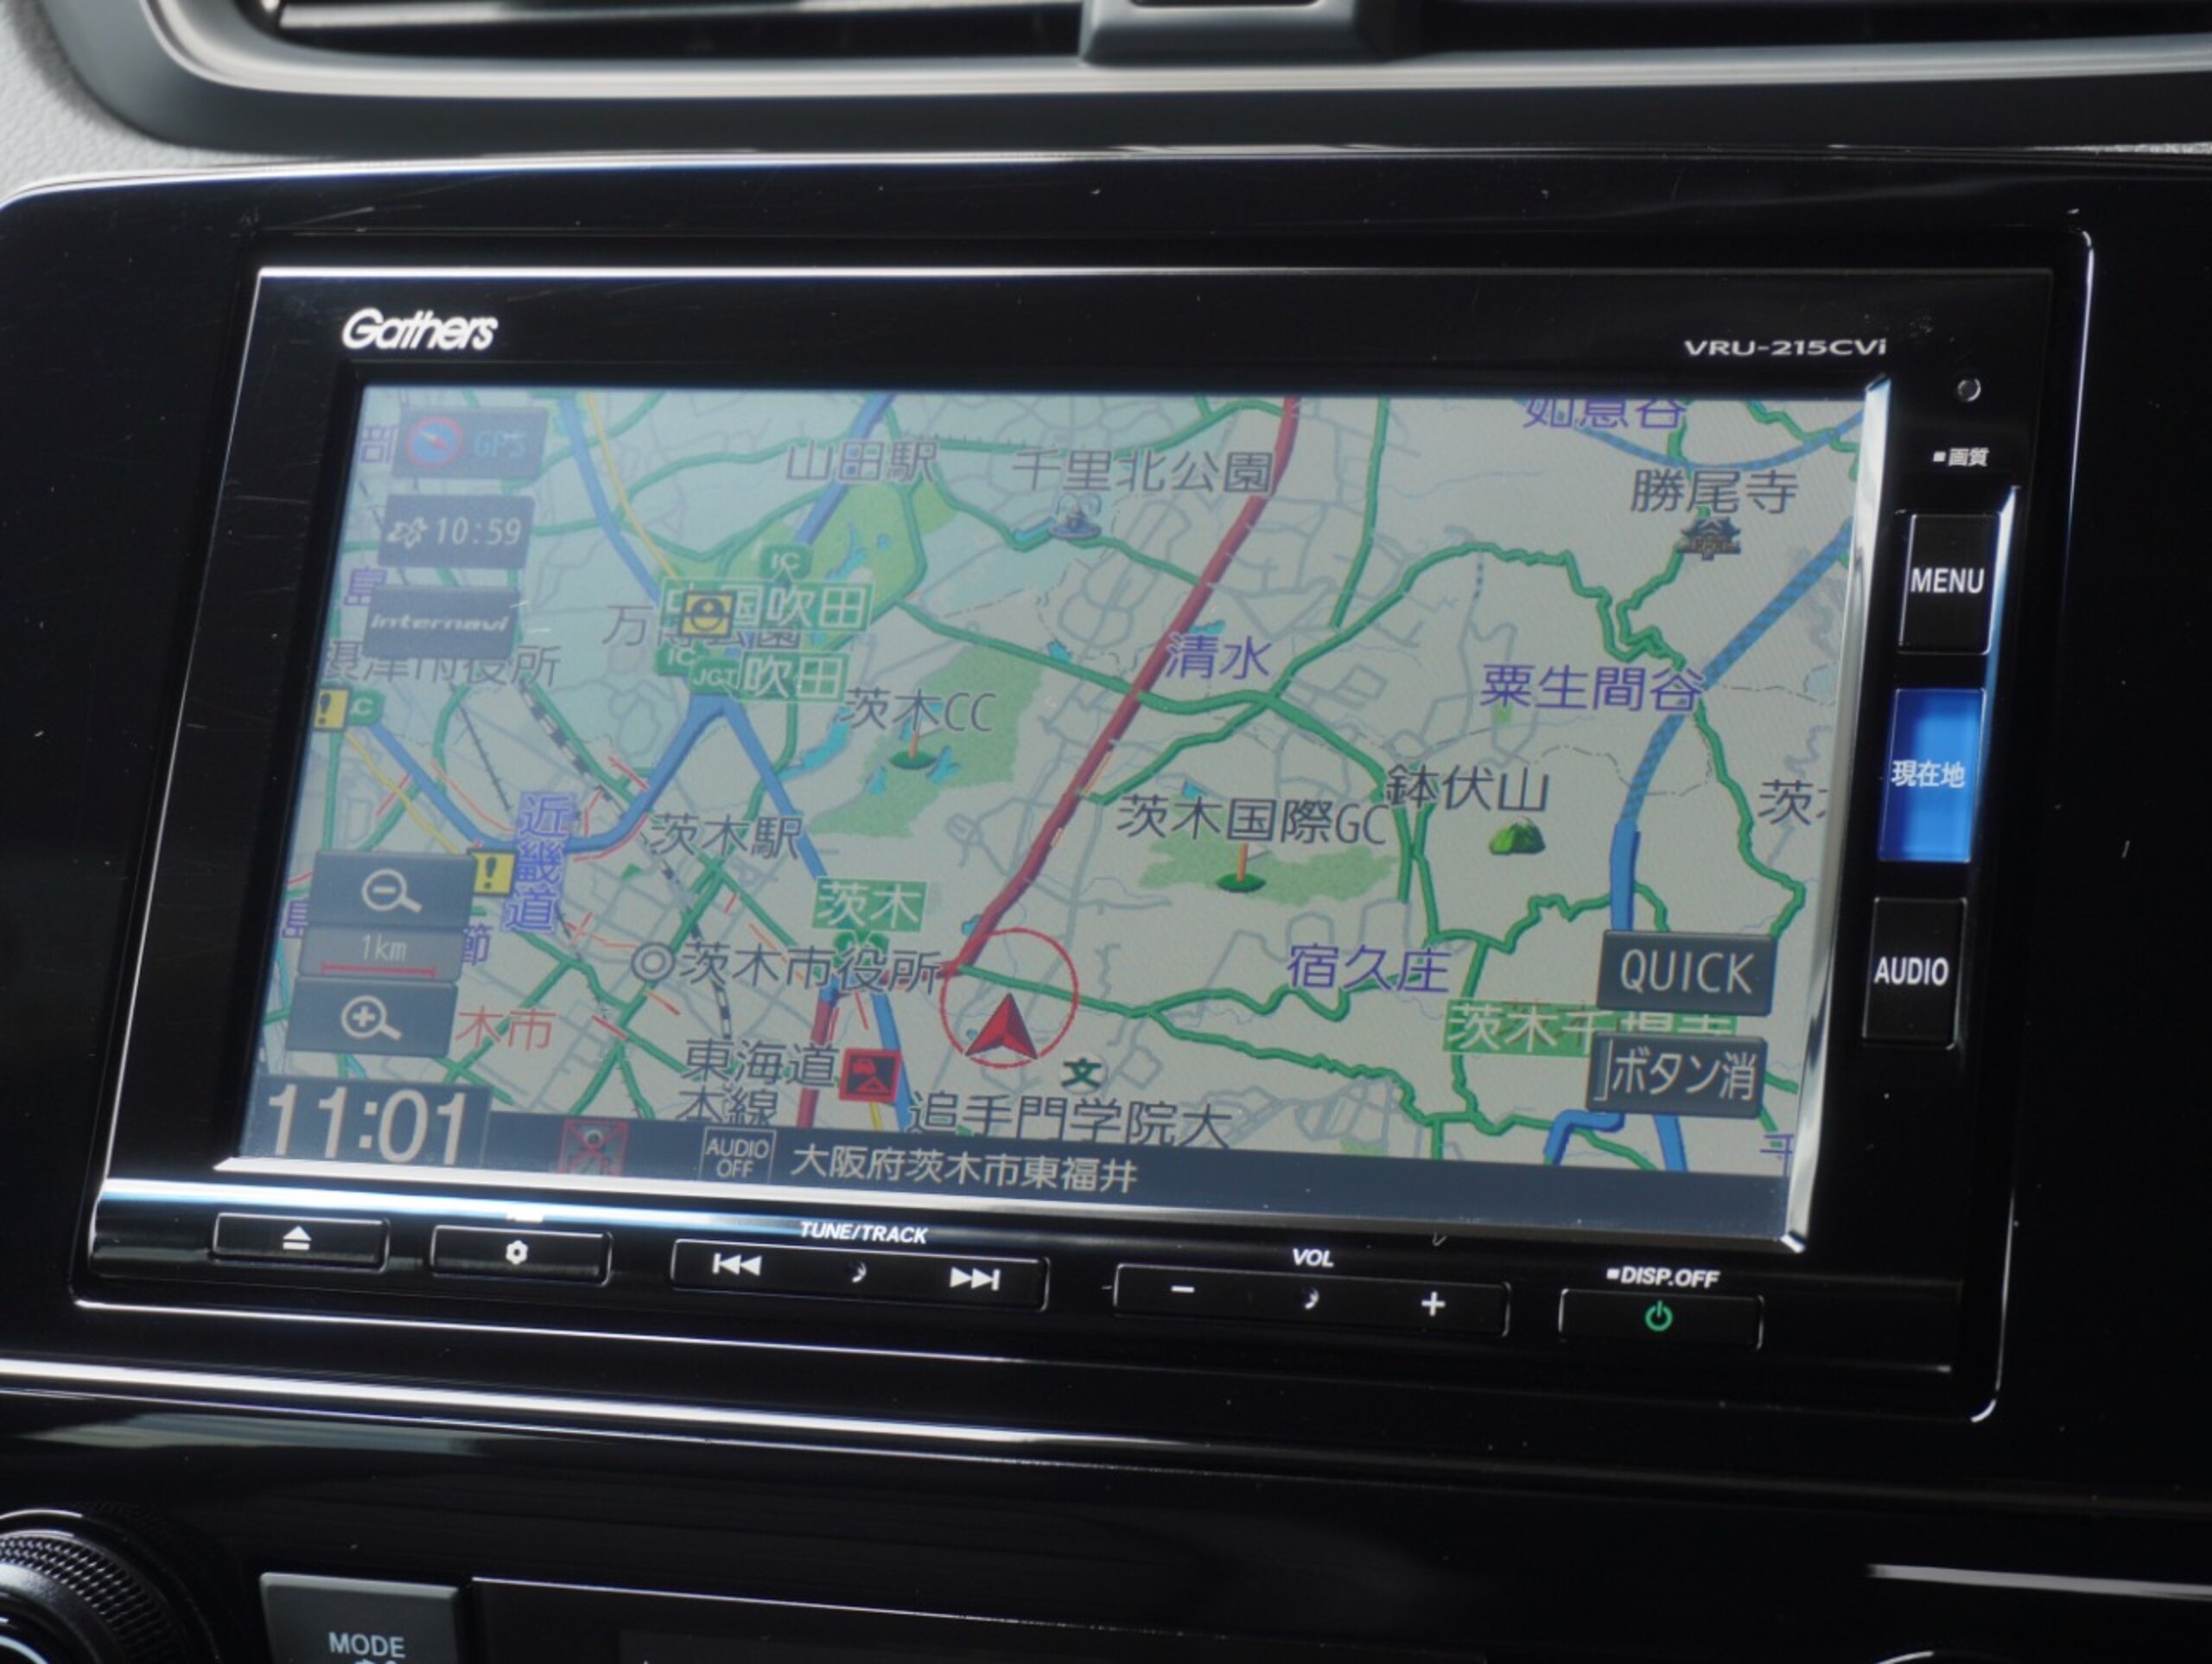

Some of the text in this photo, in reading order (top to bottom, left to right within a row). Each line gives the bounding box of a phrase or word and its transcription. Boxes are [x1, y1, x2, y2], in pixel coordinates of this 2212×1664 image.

[342, 308, 499, 350] Gathers
[1684, 339, 1887, 356] VRU-215CVi
[476, 431, 527, 457] GPS
[786, 440, 938, 482] 山田駅
[1948, 448, 1989, 467] 画質
[1012, 449, 1274, 494] 千里北公園
[1630, 469, 1799, 514] 勝尾寺
[438, 518, 521, 545] 10:59
[1910, 568, 1985, 594] MENU
[371, 613, 511, 632] internavi
[742, 656, 844, 699] 吹田
[1164, 633, 1273, 680] 清水
[837, 687, 997, 732] 茨木CC
[1479, 663, 1704, 712] 粟生間谷
[1386, 765, 1549, 812] 鉢伏山
[1891, 759, 1965, 788] 現在地
[1116, 793, 1387, 845] 茨木国際GC
[1758, 779, 1828, 826] 茨
[649, 811, 803, 860] 茨木駅
[505, 796, 570, 930] 近畿道
[817, 881, 922, 929] 茨木
[362, 934, 408, 961] 1km
[679, 942, 941, 995] 茨木市役所
[1287, 944, 1452, 994] 宿久庄
[1620, 949, 1755, 994] QUICK
[1874, 956, 1949, 986] AUDIO
[682, 1038, 840, 1088] 東海道
[1612, 1045, 1758, 1101] ボタン消
[268, 1083, 466, 1165] 11:01
[907, 1089, 1232, 1149] 追手門学院大
[705, 1139, 770, 1159] AUDIO
[716, 1159, 753, 1178] OFF
[790, 1143, 1138, 1194] 大阪府茨木市東福井
[800, 1221, 929, 1245] TUNE/TRACK
[1293, 1248, 1334, 1267] VOL
[1621, 1266, 1720, 1289] DISP.OFF
[328, 1632, 406, 1658] MODE
